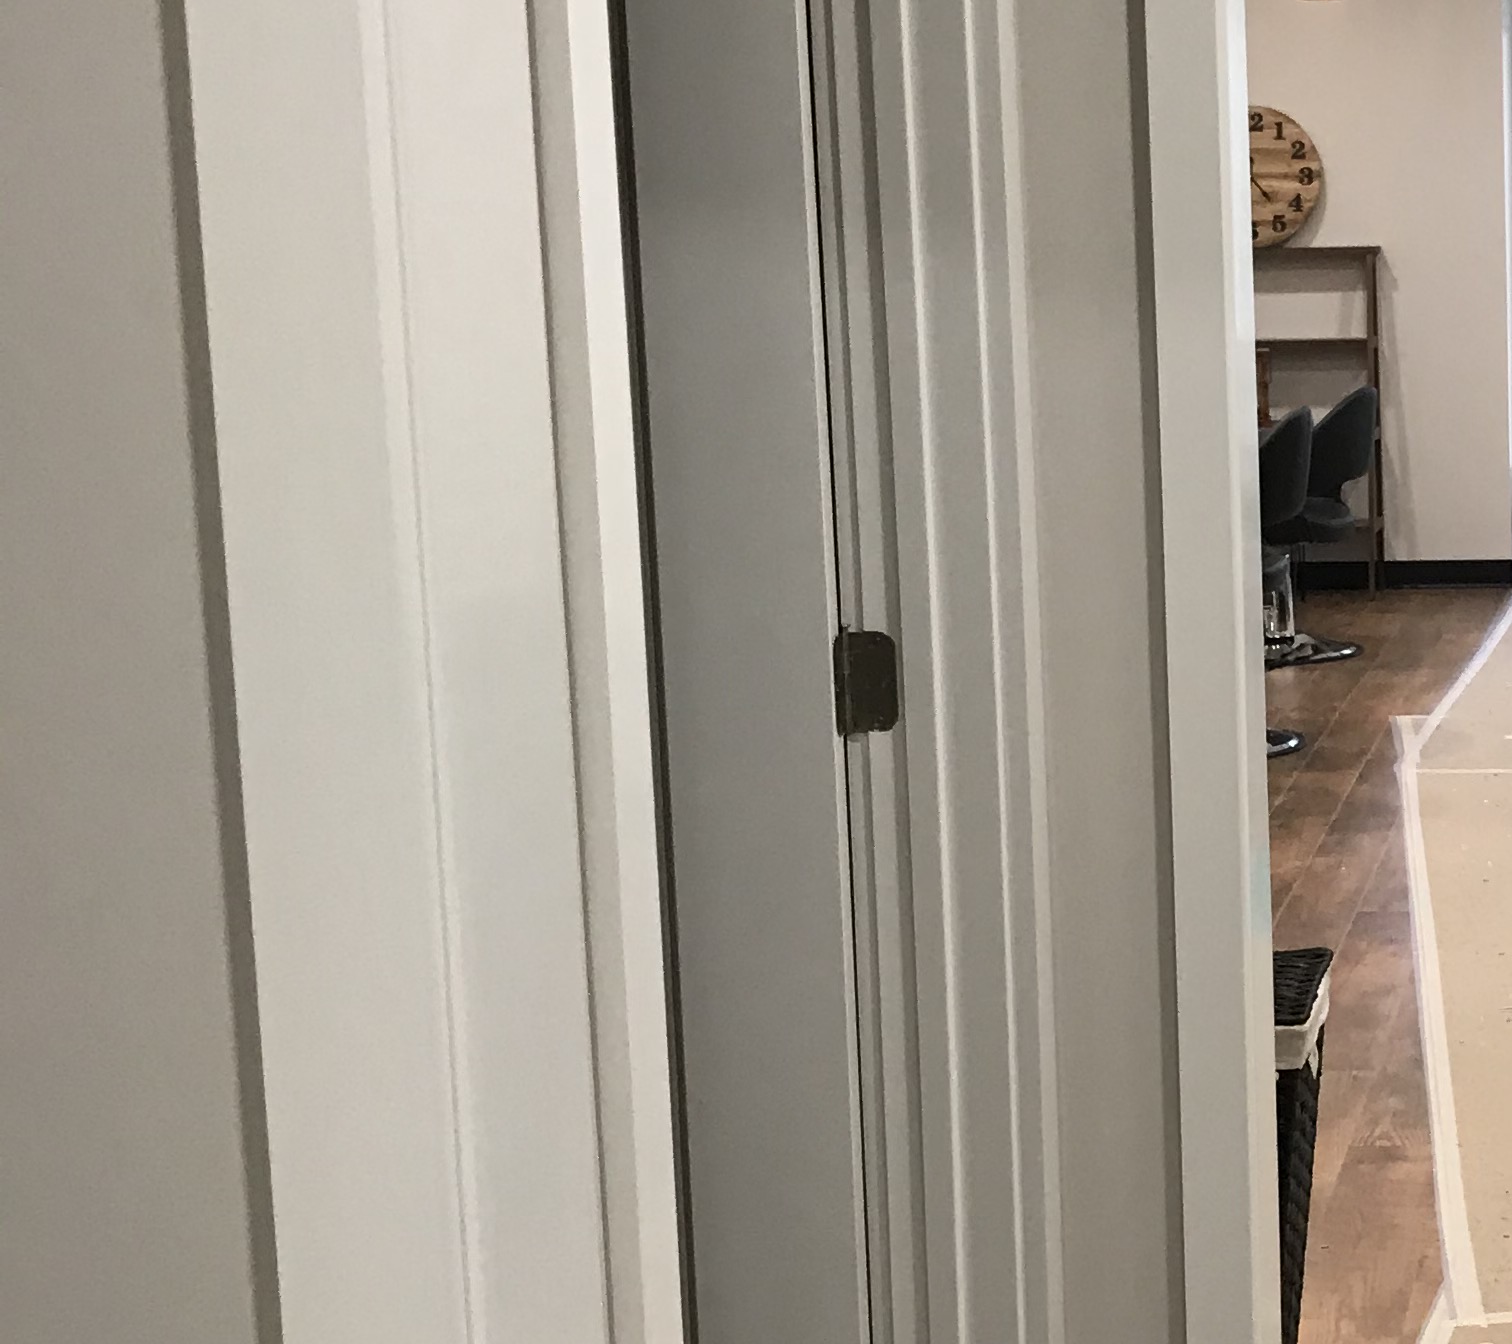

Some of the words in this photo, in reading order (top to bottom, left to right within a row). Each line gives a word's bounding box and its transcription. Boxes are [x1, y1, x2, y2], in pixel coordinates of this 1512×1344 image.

[1249, 111, 1264, 132] 2
[1273, 121, 1286, 141] 1
[1291, 139, 1306, 160] 2
[1298, 166, 1314, 186] 3
[1288, 193, 1303, 212] 4
[1272, 214, 1287, 233] 5
